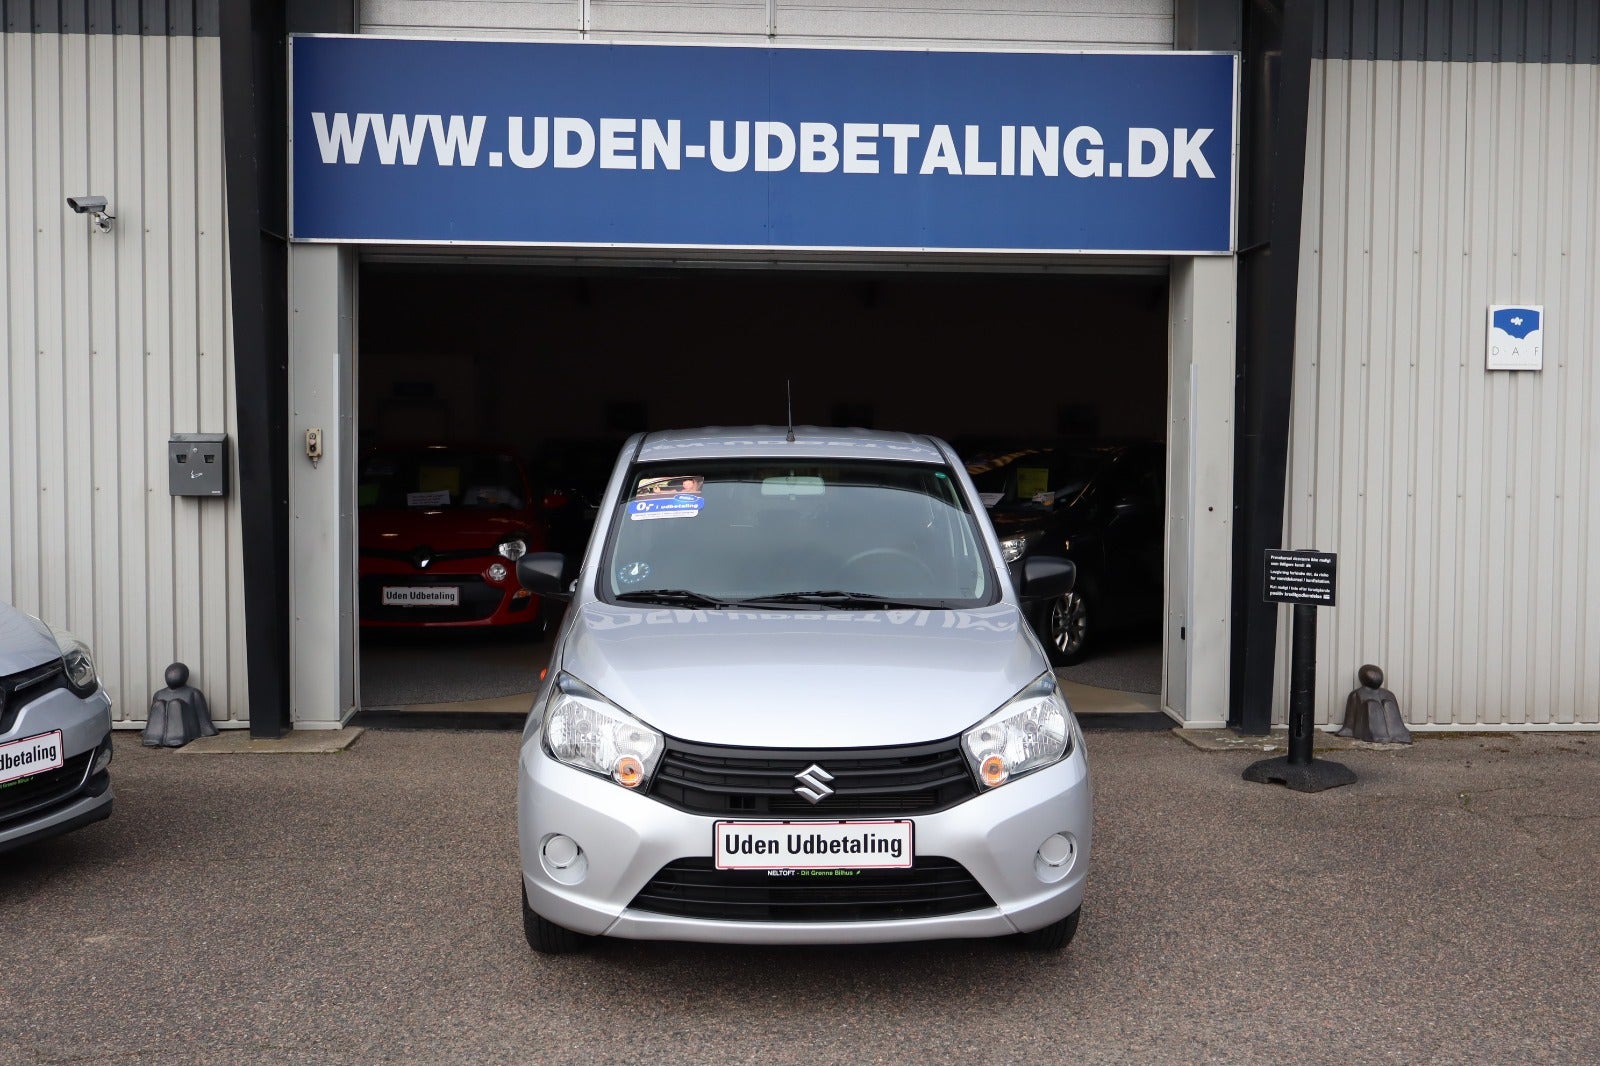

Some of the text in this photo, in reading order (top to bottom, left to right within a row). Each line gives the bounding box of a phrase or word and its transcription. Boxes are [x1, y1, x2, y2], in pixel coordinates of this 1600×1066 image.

[311, 111, 1216, 179] WWW.UDEN-UDBETALING.DK
[386, 591, 455, 601] Uden Udbetaling
[0, 745, 56, 771] dbetaling
[725, 833, 902, 858] Uden Udbetaling
